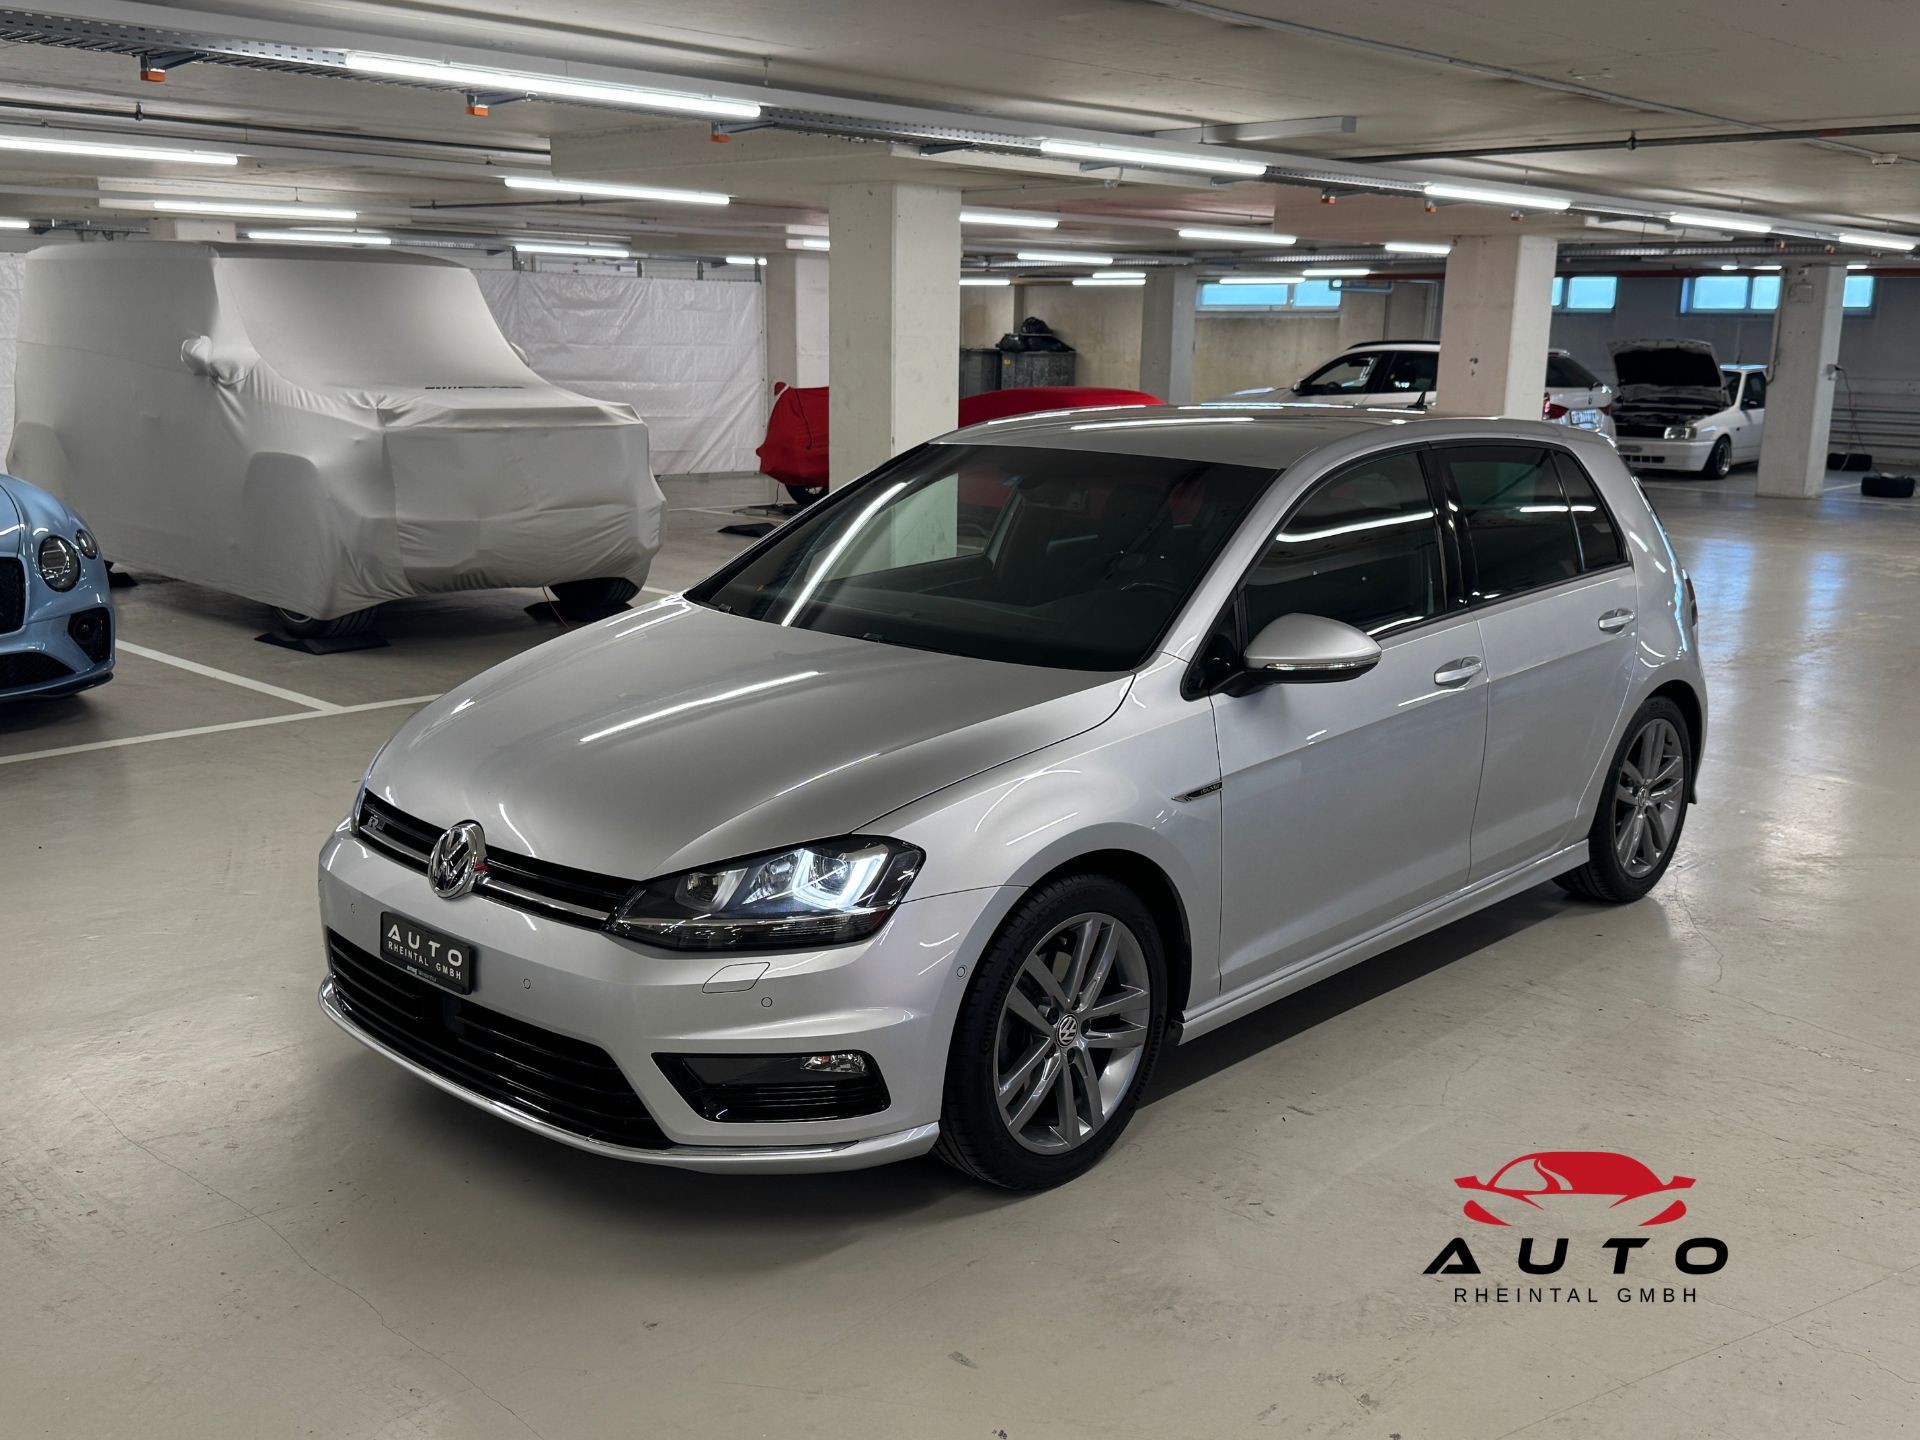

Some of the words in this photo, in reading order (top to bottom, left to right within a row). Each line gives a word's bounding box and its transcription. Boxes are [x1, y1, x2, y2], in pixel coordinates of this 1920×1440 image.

[387, 923, 463, 967] AUTO
[388, 941, 429, 967] RHEINTAL
[435, 962, 462, 980] GMBH
